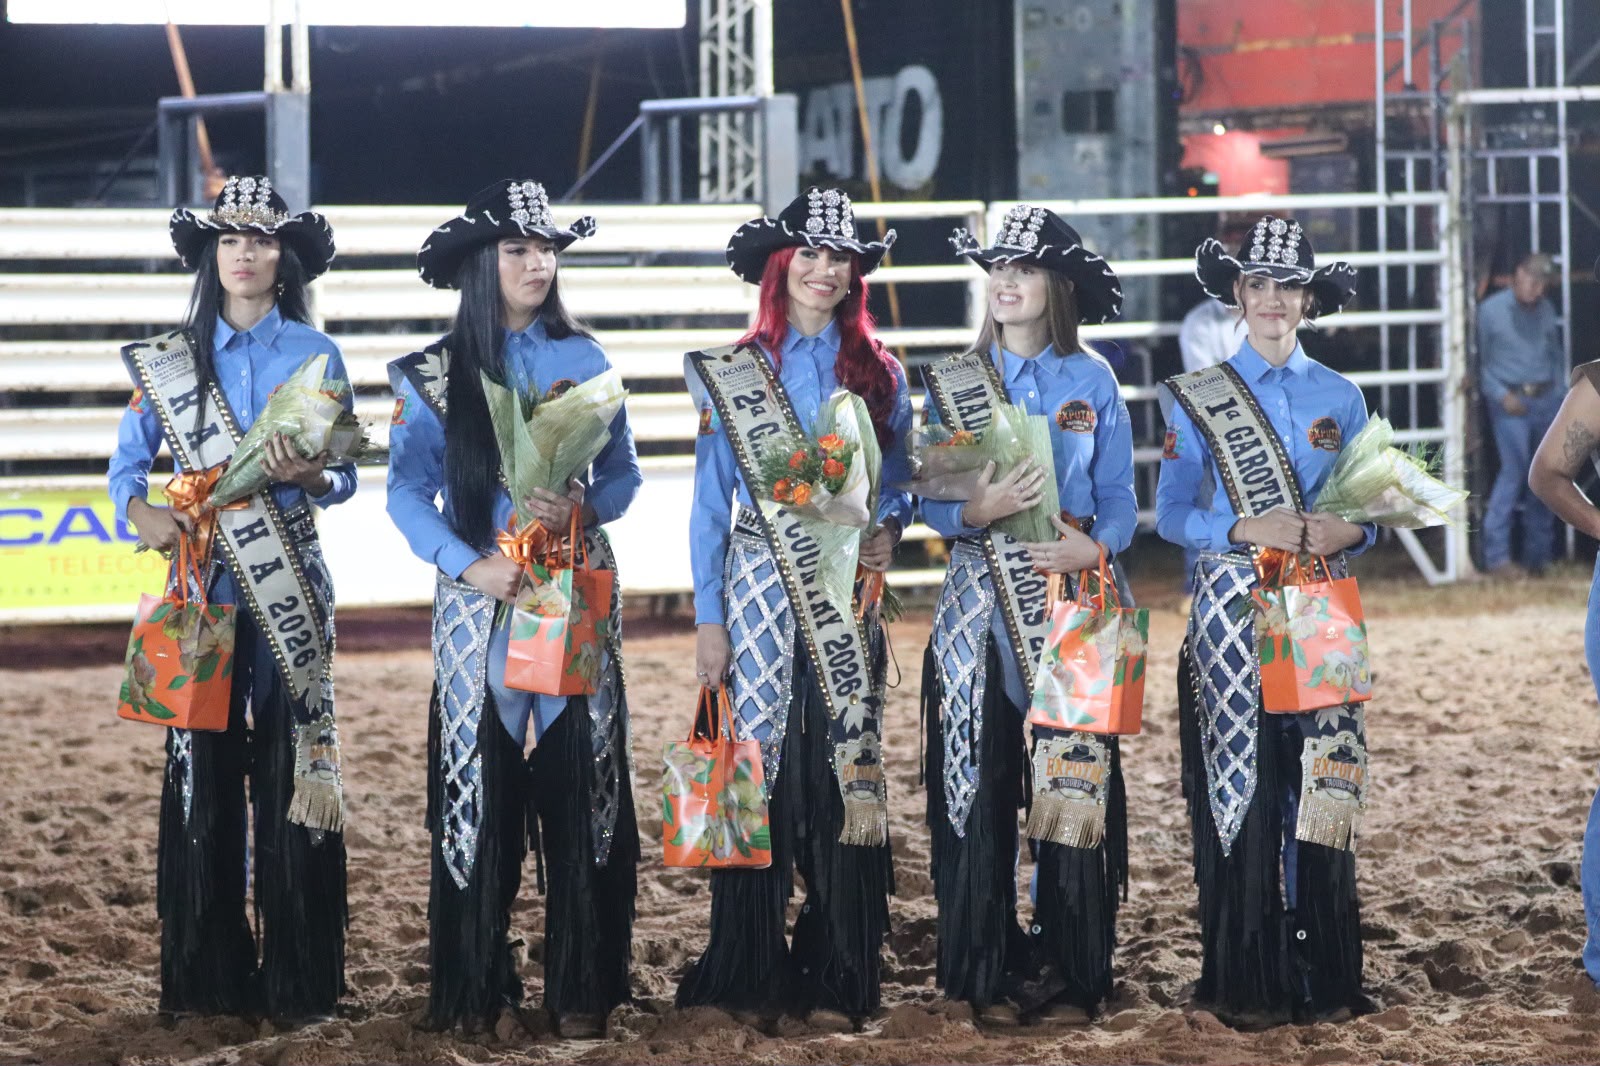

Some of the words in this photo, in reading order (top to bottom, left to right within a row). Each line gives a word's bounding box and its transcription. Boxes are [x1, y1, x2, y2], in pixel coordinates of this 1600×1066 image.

[148, 349, 189, 371] TACURU
[716, 362, 756, 379] TACURU
[1186, 374, 1225, 391] TACURU
[1223, 425, 1286, 517] GAROTA
[267, 595, 317, 669] 2026
[822, 633, 862, 698] 2026
